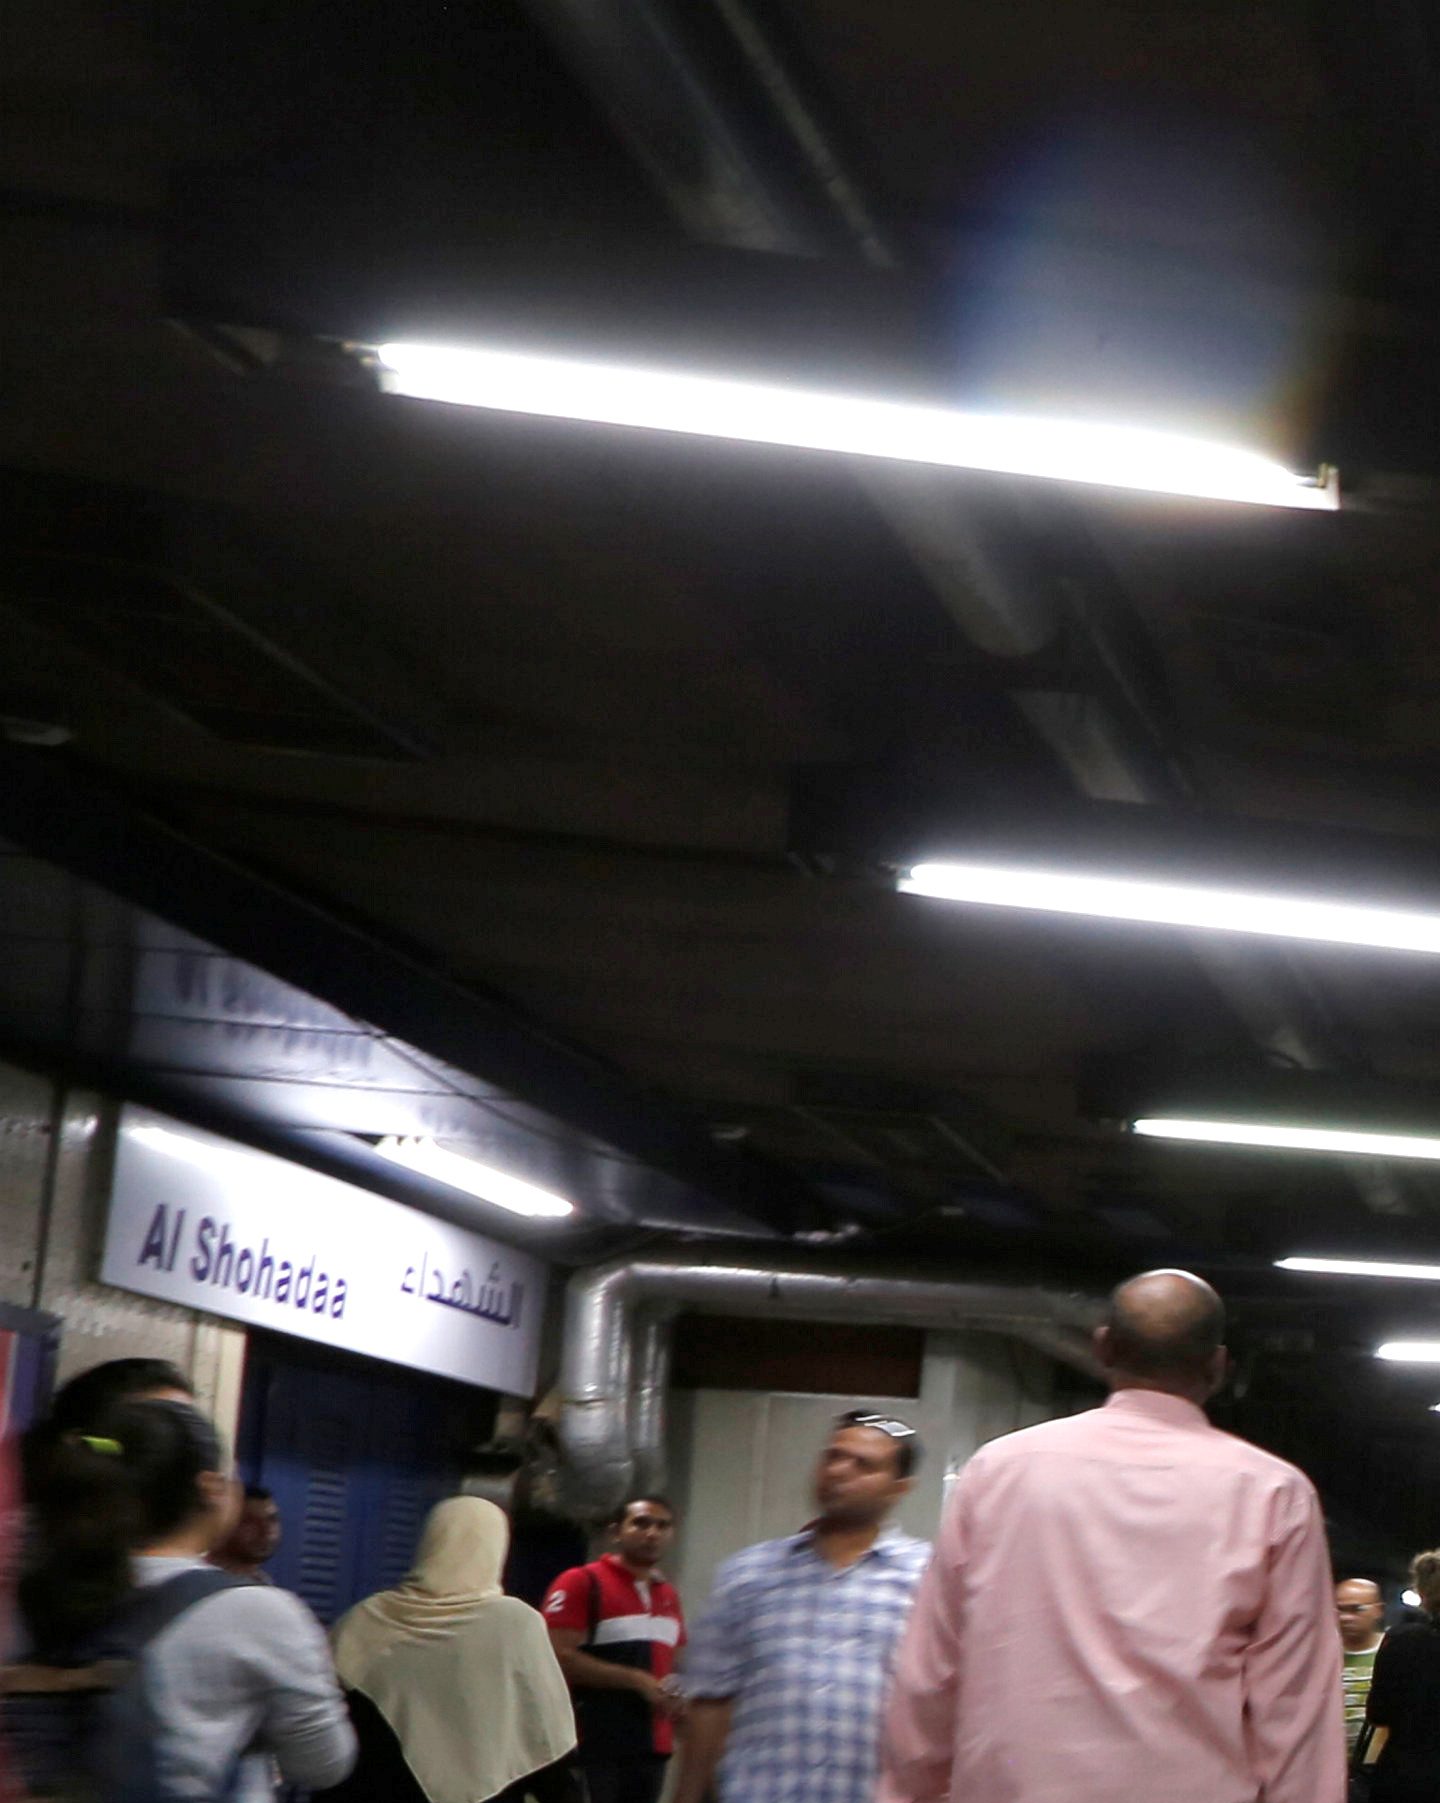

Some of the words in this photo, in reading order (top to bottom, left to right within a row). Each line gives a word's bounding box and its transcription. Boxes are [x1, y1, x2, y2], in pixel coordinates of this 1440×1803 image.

[137, 1203, 186, 1271] Al
[190, 1216, 348, 1319] Shohadaa
[400, 1251, 523, 1329] الشهداء
[544, 1589, 567, 1613] 2
